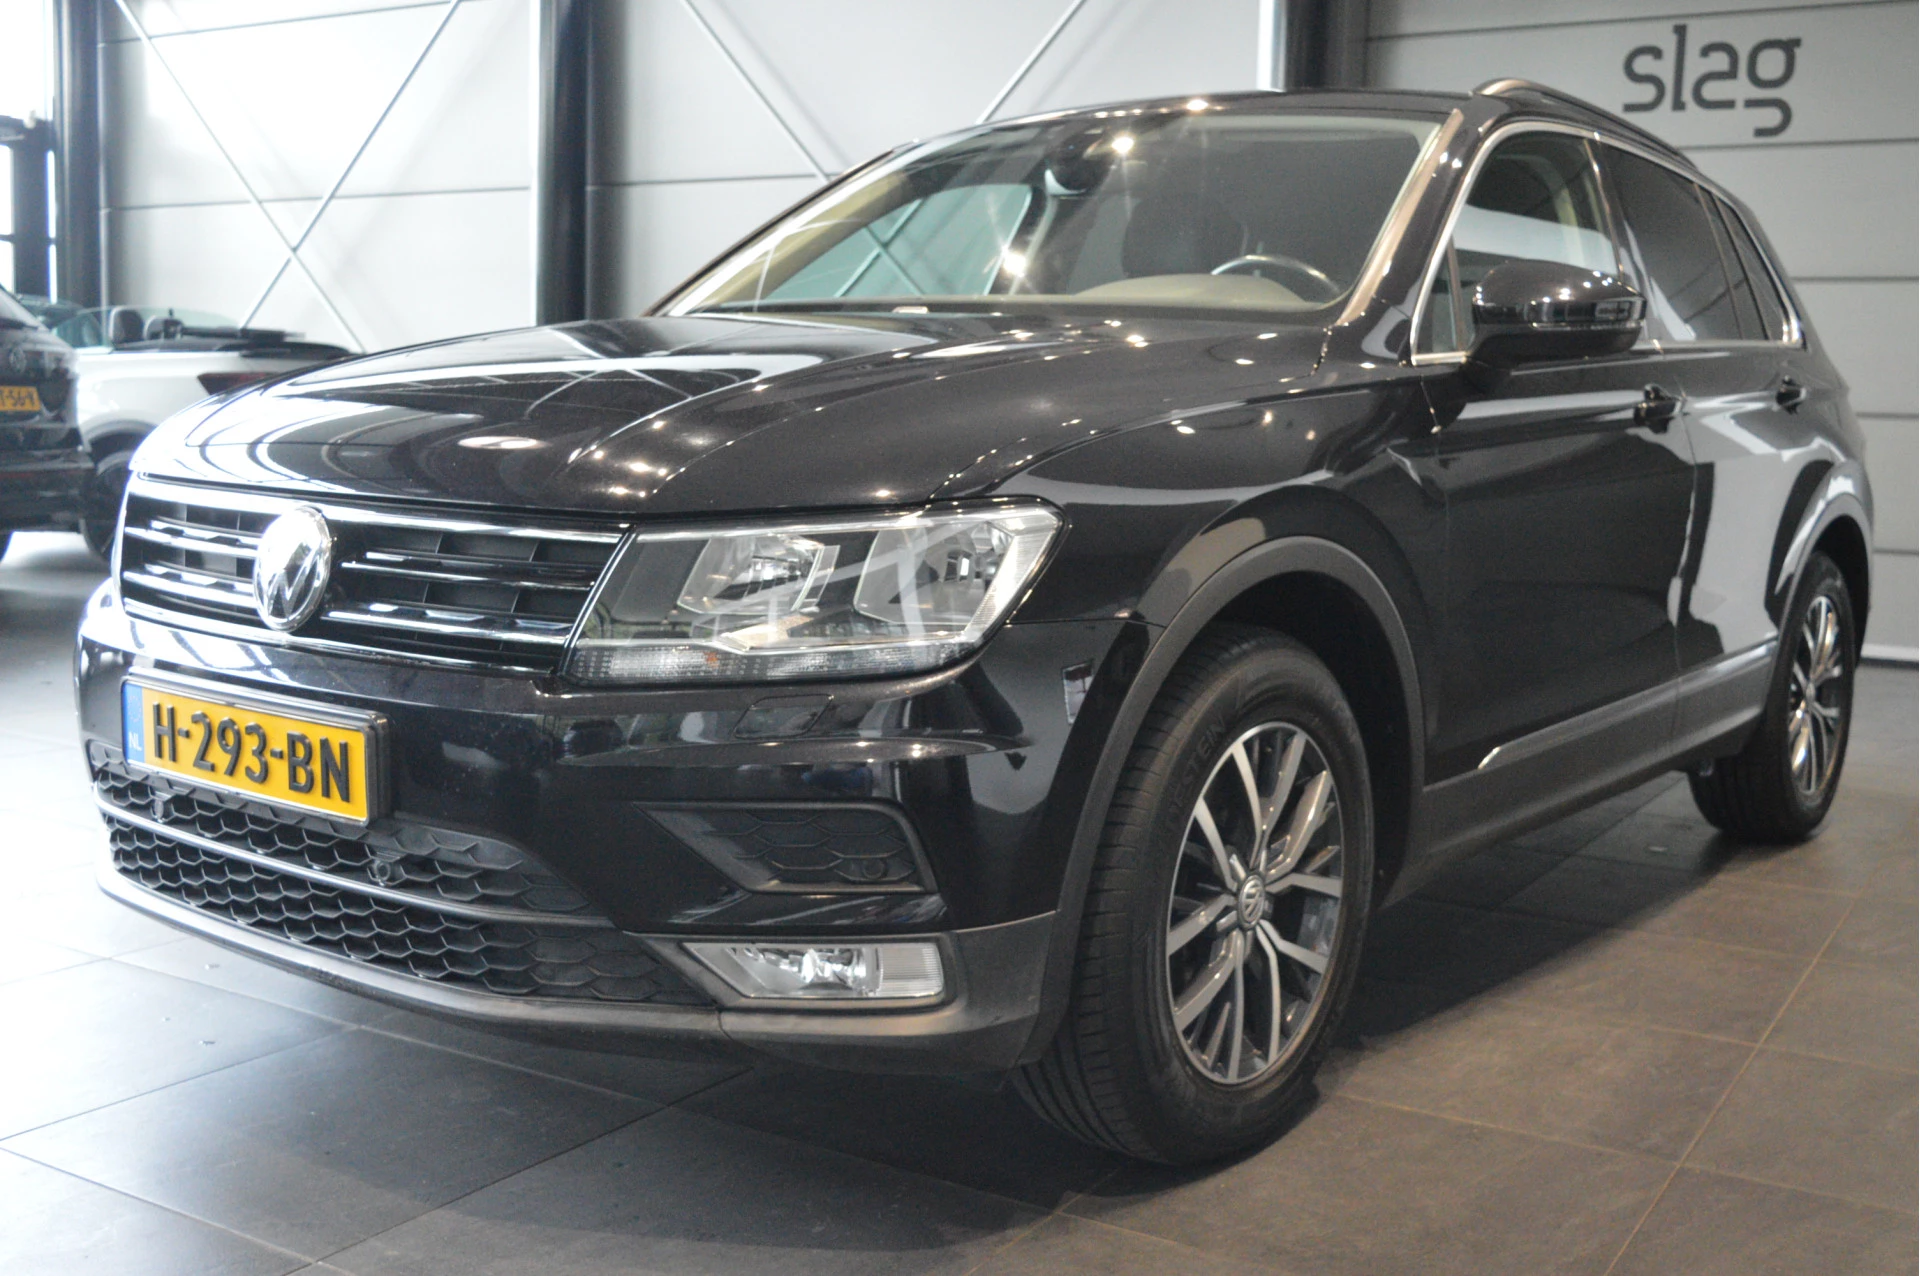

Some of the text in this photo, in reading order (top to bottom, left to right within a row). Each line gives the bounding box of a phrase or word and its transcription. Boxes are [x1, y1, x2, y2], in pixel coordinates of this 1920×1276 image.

[1623, 24, 1802, 137] slag
[128, 731, 142, 751] NL
[153, 702, 350, 803] H-293-BN
